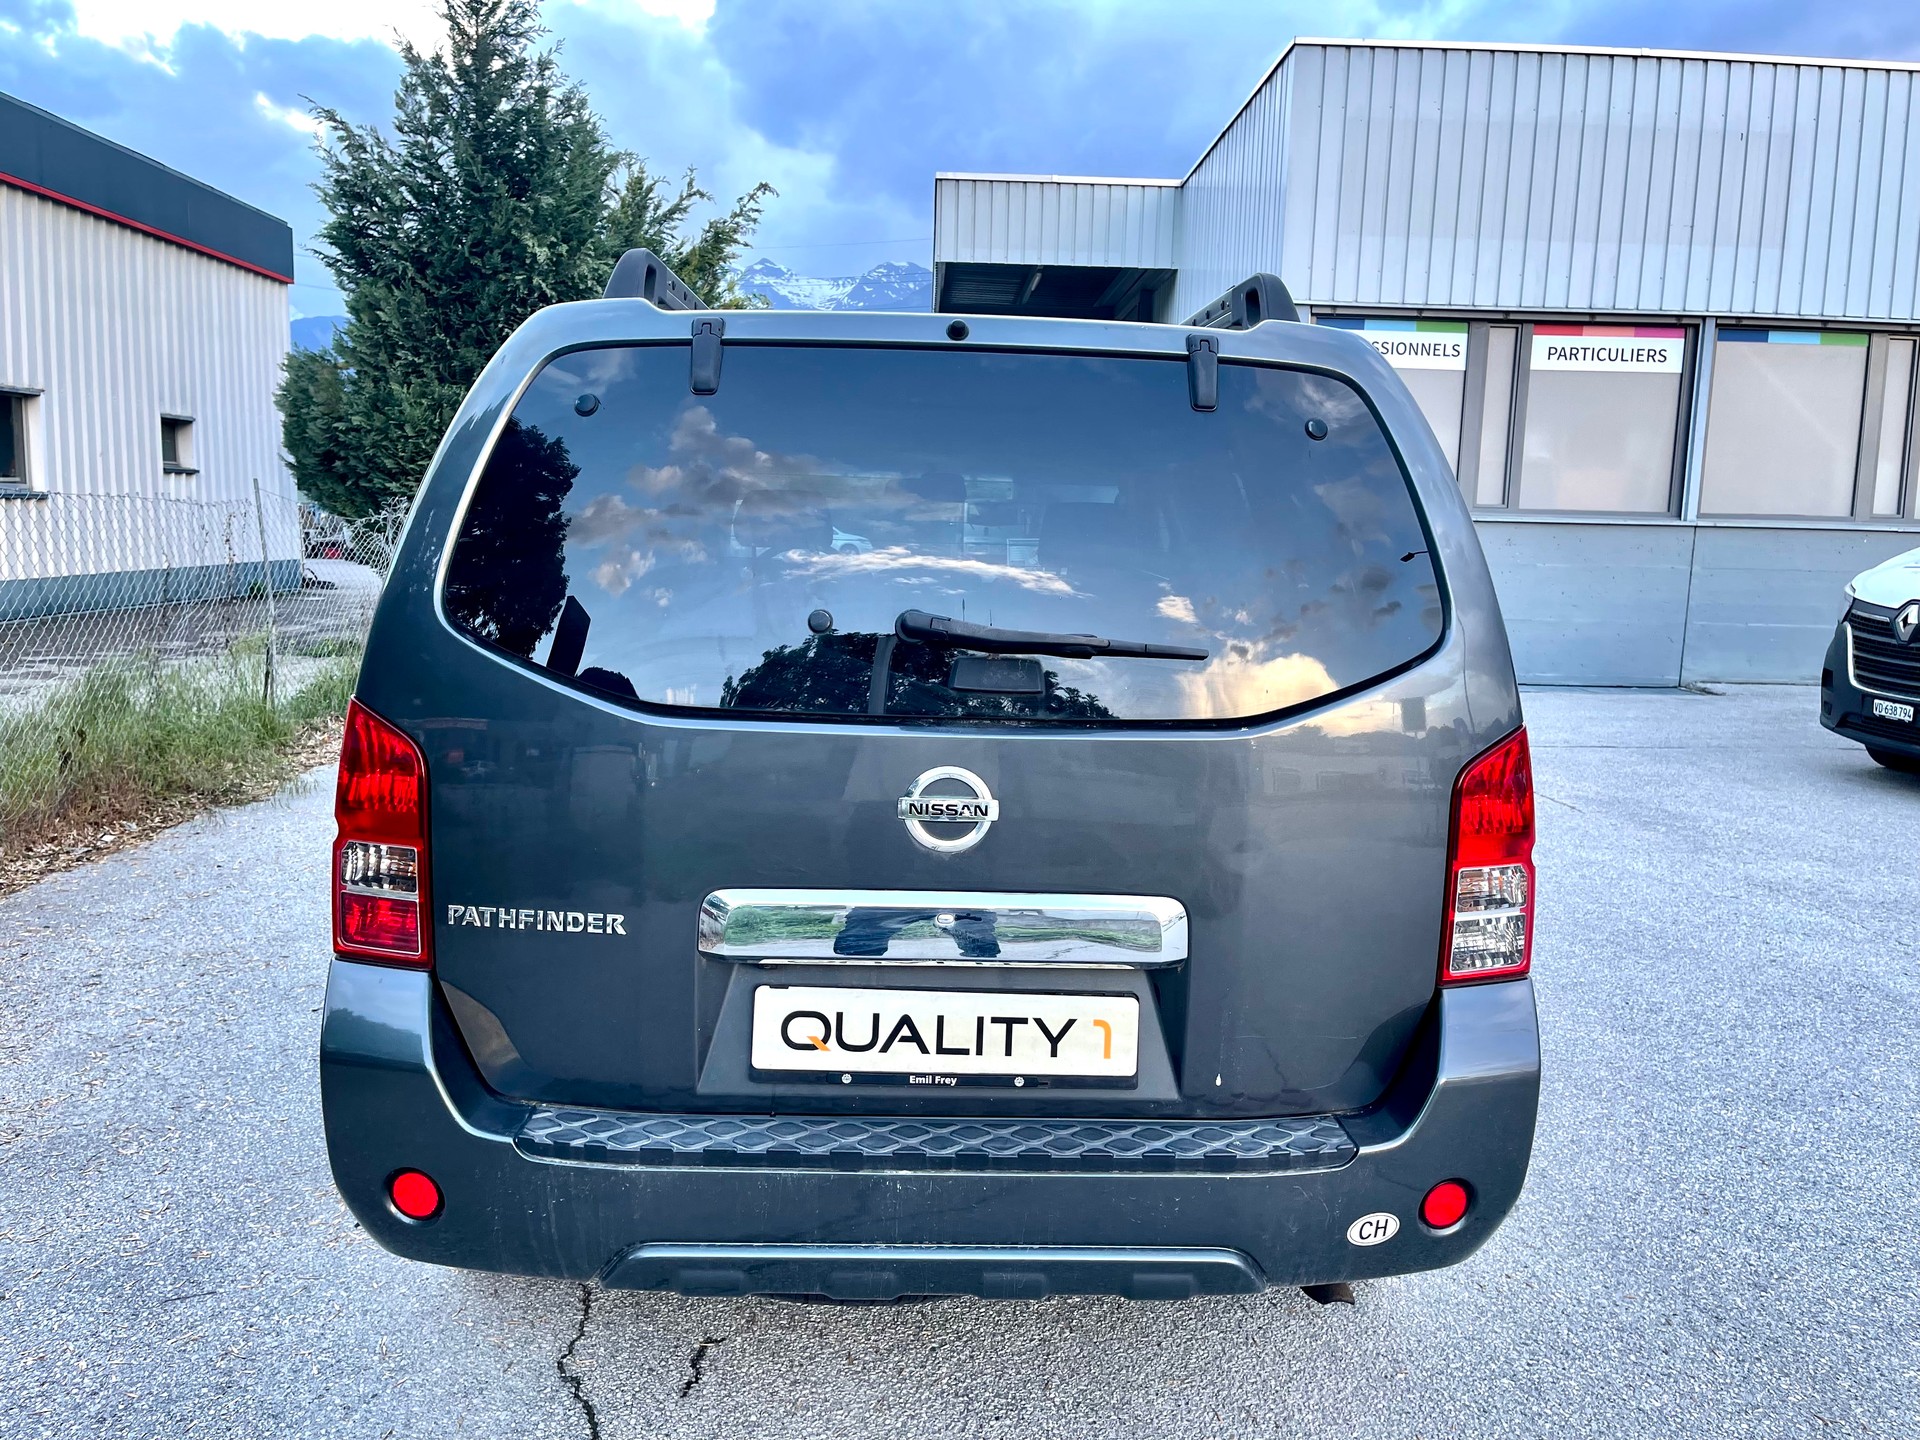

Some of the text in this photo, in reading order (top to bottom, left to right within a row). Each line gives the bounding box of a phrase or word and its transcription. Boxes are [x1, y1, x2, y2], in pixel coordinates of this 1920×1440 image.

[1547, 346, 1668, 363] PARTICULIERS
[1875, 702, 1912, 719] VD 638 794
[908, 803, 989, 817] NISSAN
[447, 904, 627, 936] PATHFINDER
[780, 1010, 1112, 1060] QUALITY 1
[909, 1075, 957, 1087] Emil Frey
[1358, 1218, 1389, 1240] CH
